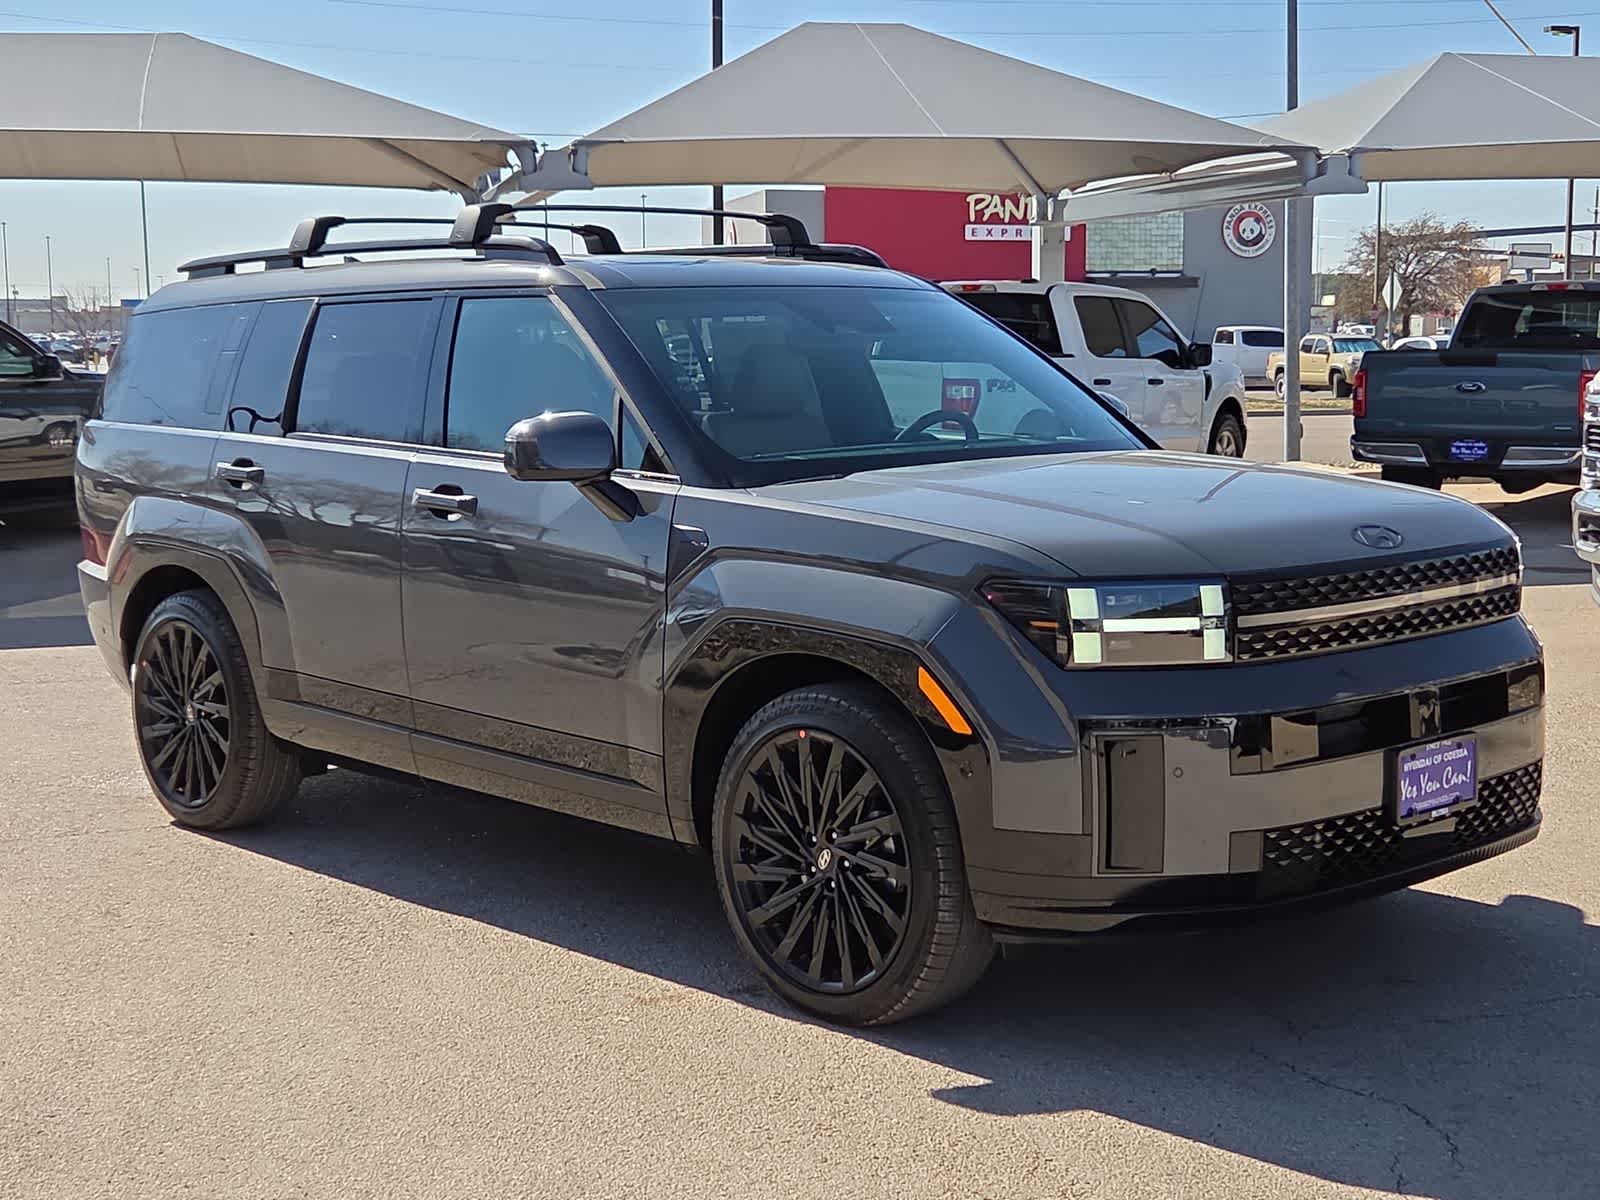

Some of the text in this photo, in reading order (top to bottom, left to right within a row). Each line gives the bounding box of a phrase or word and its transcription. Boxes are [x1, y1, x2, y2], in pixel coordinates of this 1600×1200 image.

[970, 227, 1033, 238] EXPR
[1401, 760, 1471, 801] Yes You Can!
